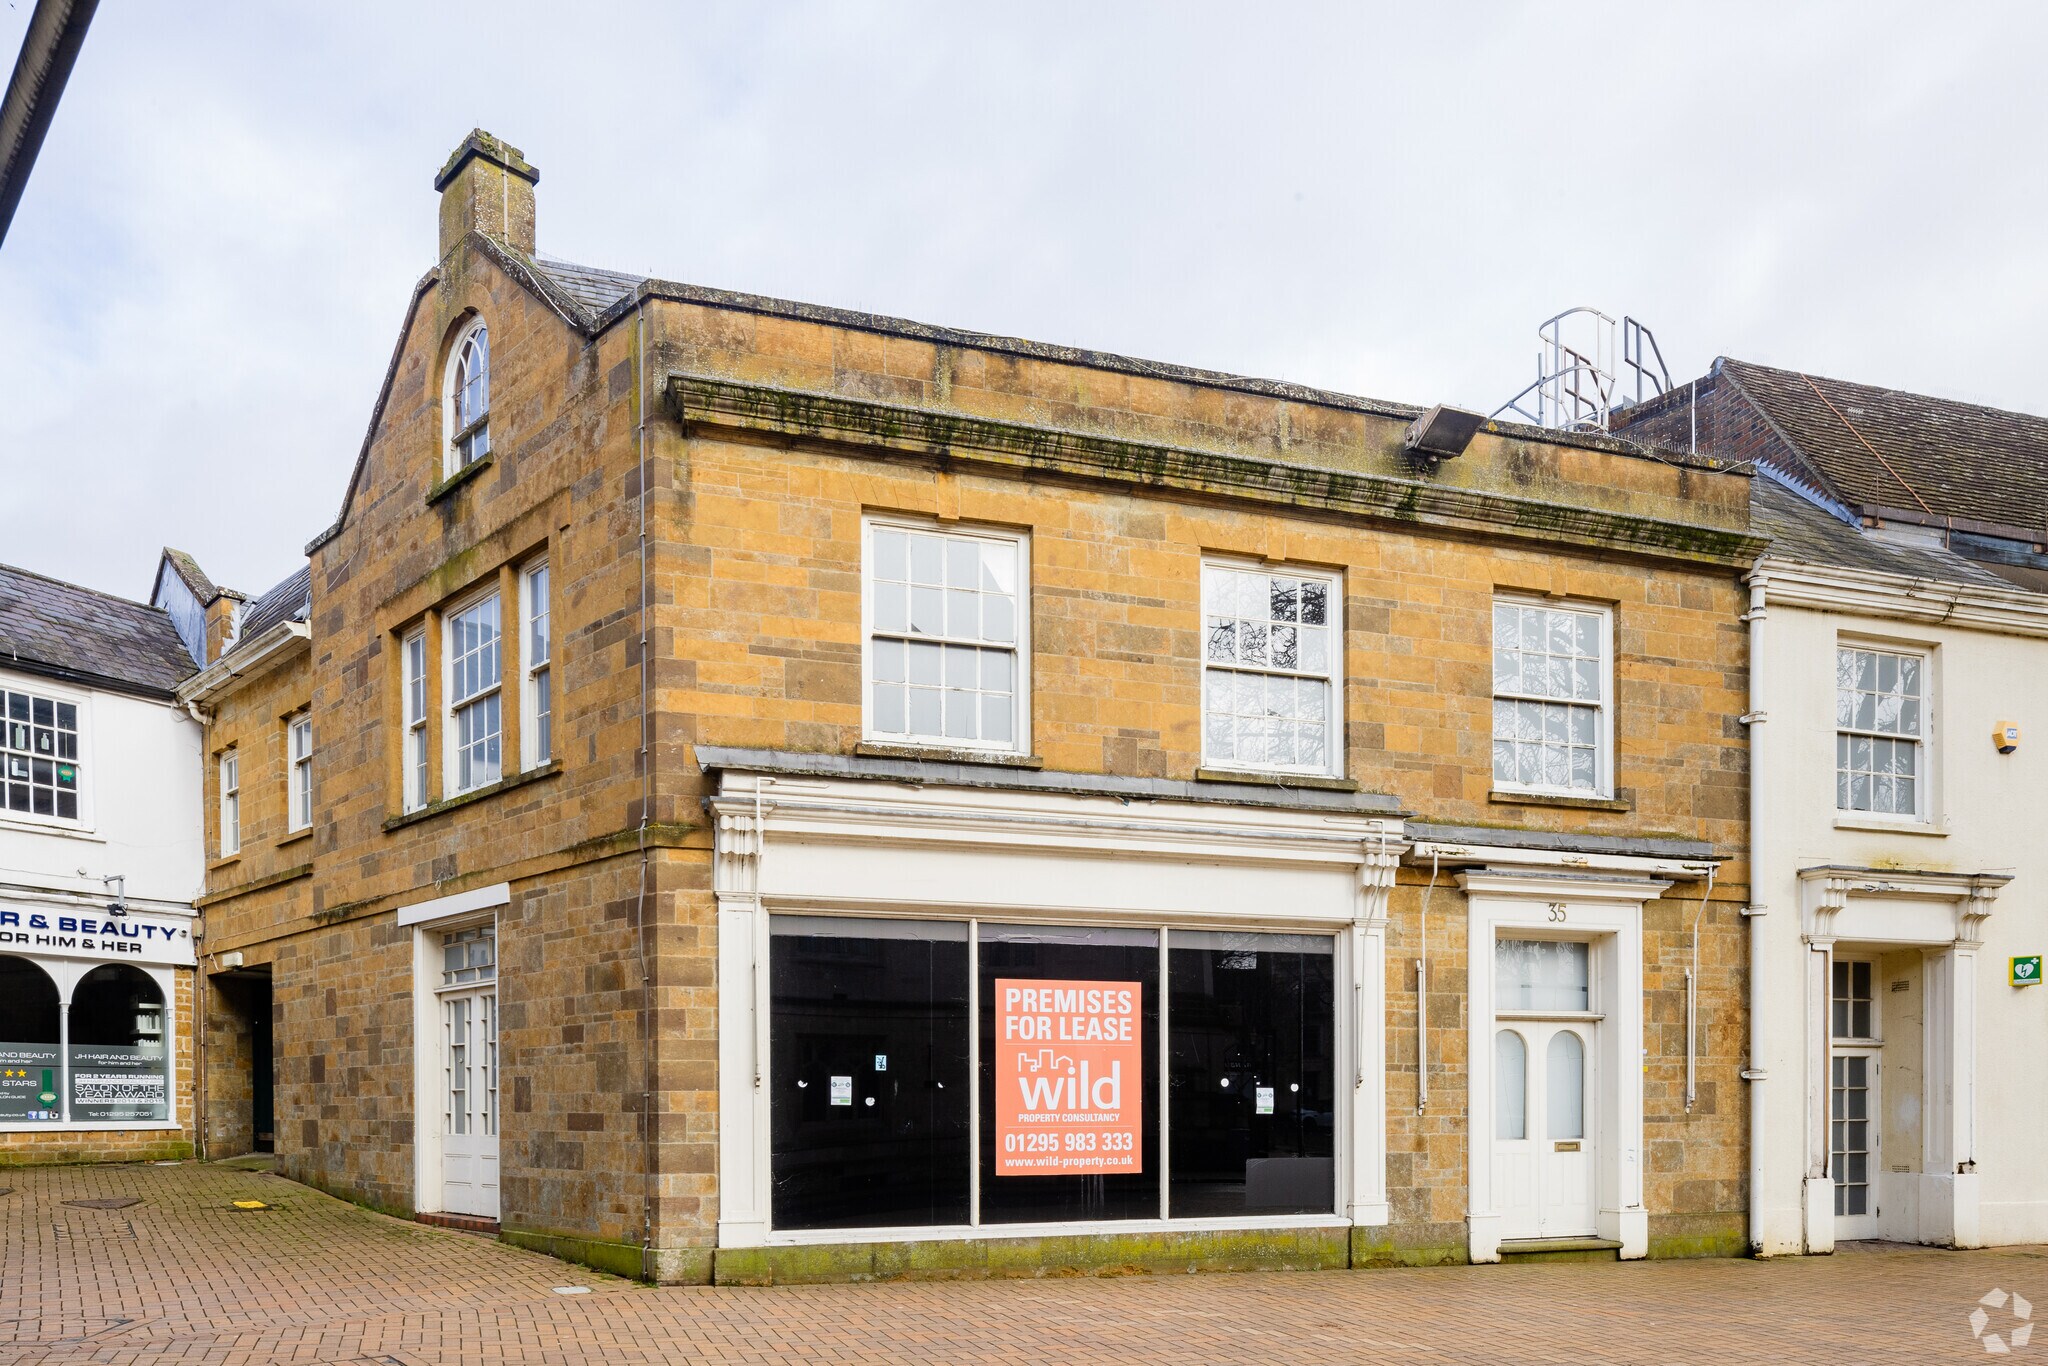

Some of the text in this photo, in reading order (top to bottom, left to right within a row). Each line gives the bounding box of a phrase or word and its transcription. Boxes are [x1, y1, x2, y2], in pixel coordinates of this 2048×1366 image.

[1547, 902, 1567, 923] 35
[29, 914, 49, 930] &
[59, 916, 177, 941] BEAUTY
[36, 934, 76, 948] HIM
[81, 938, 95, 950] &
[101, 940, 142, 954] HER
[1005, 988, 1132, 1015] PREMISES
[1005, 1015, 1133, 1041] FOR LEASE
[75, 1084, 165, 1092] SALON OF THE
[1018, 1060, 1121, 1111] wild
[1018, 1113, 1120, 1123] PROPERTY CONSULTANCY
[1005, 1132, 1133, 1153] 01295 983 333
[1005, 1154, 1133, 1169] www.wild-property.co.uk
